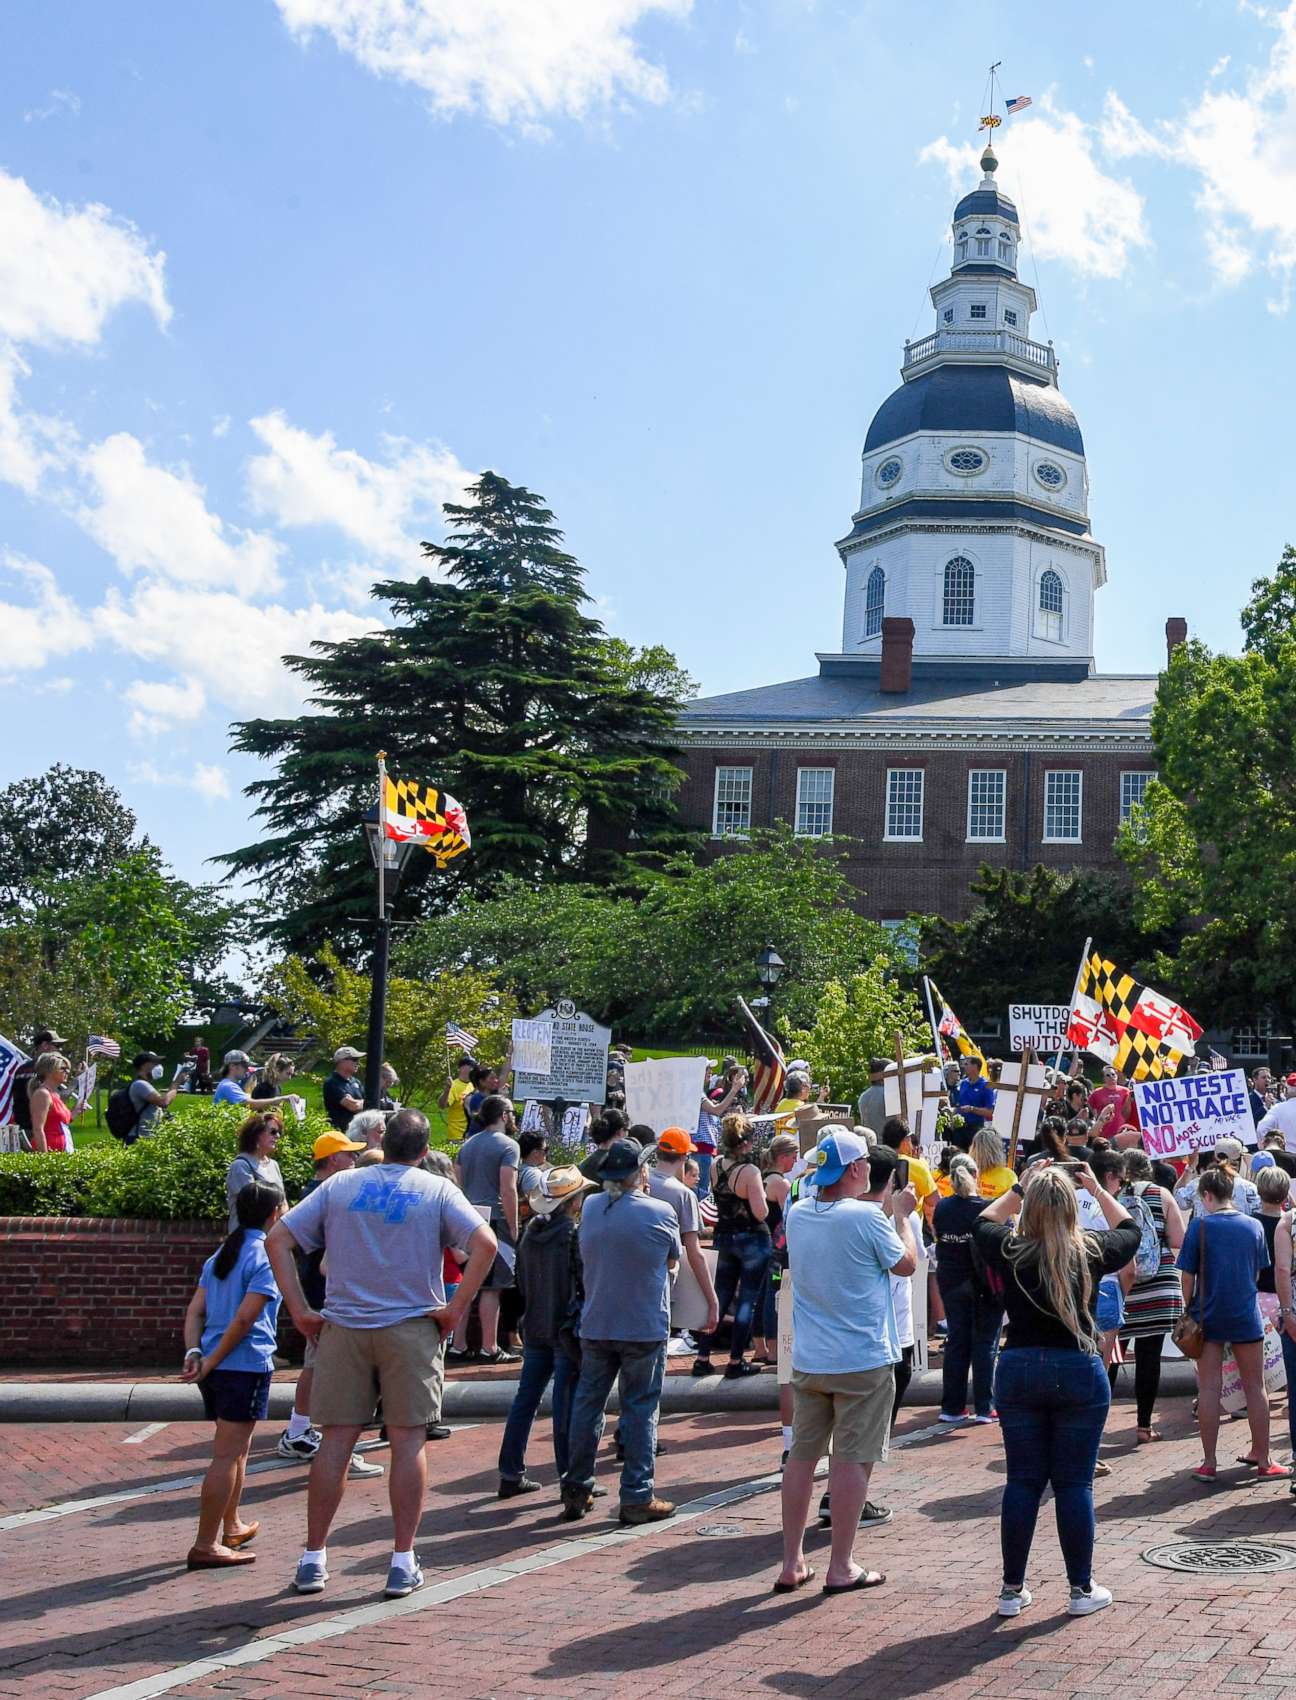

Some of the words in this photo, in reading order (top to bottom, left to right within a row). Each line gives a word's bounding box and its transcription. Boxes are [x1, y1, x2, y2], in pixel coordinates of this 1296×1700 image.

[1012, 1006, 1070, 1020] SHUTDO
[1034, 1021, 1067, 1035] THE
[1142, 1081, 1177, 1104] NO
[1180, 1072, 1236, 1099] TEST
[1139, 1101, 1174, 1128] NO
[1172, 1092, 1248, 1122] TRACE
[1141, 1124, 1177, 1156] NO
[1176, 1121, 1201, 1145] MORE
[348, 1181, 424, 1225] MT
